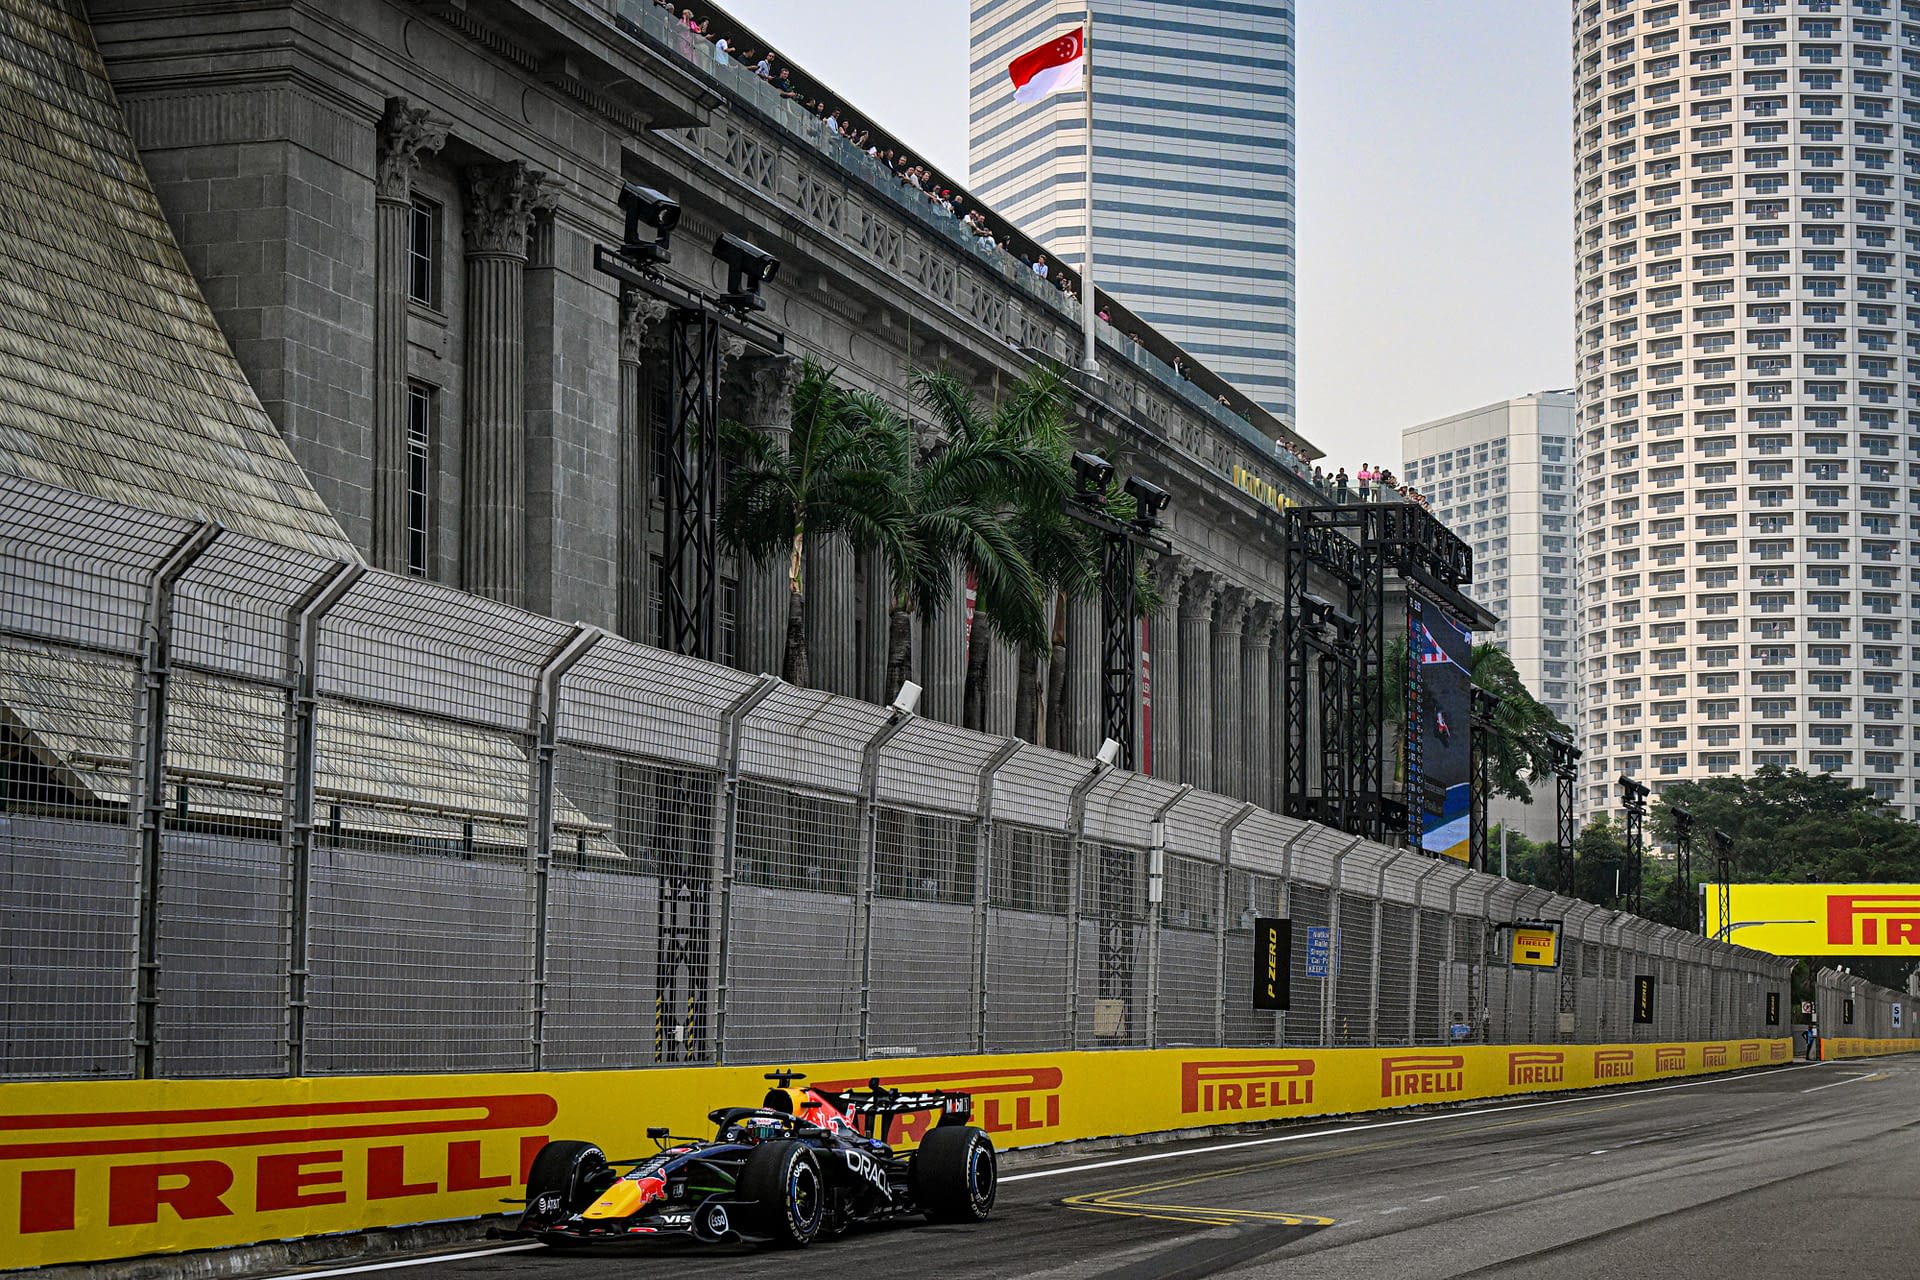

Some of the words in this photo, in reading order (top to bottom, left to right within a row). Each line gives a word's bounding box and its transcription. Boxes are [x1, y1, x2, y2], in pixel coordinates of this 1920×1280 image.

[1517, 935, 1551, 947] PIRELLI
[1267, 927, 1277, 982] ZERO
[1267, 983, 1276, 999] P
[1509, 1052, 1564, 1085] PIRELLI
[1594, 1050, 1634, 1079] PIRELLI
[1656, 1048, 1686, 1072] PIRELLI
[1703, 1046, 1727, 1068] PIRELLI
[1182, 1058, 1316, 1114] PIRELLI
[1381, 1055, 1464, 1097] PIRELLI
[547, 1197, 561, 1210] AT&T
[660, 1215, 692, 1223] VIS
